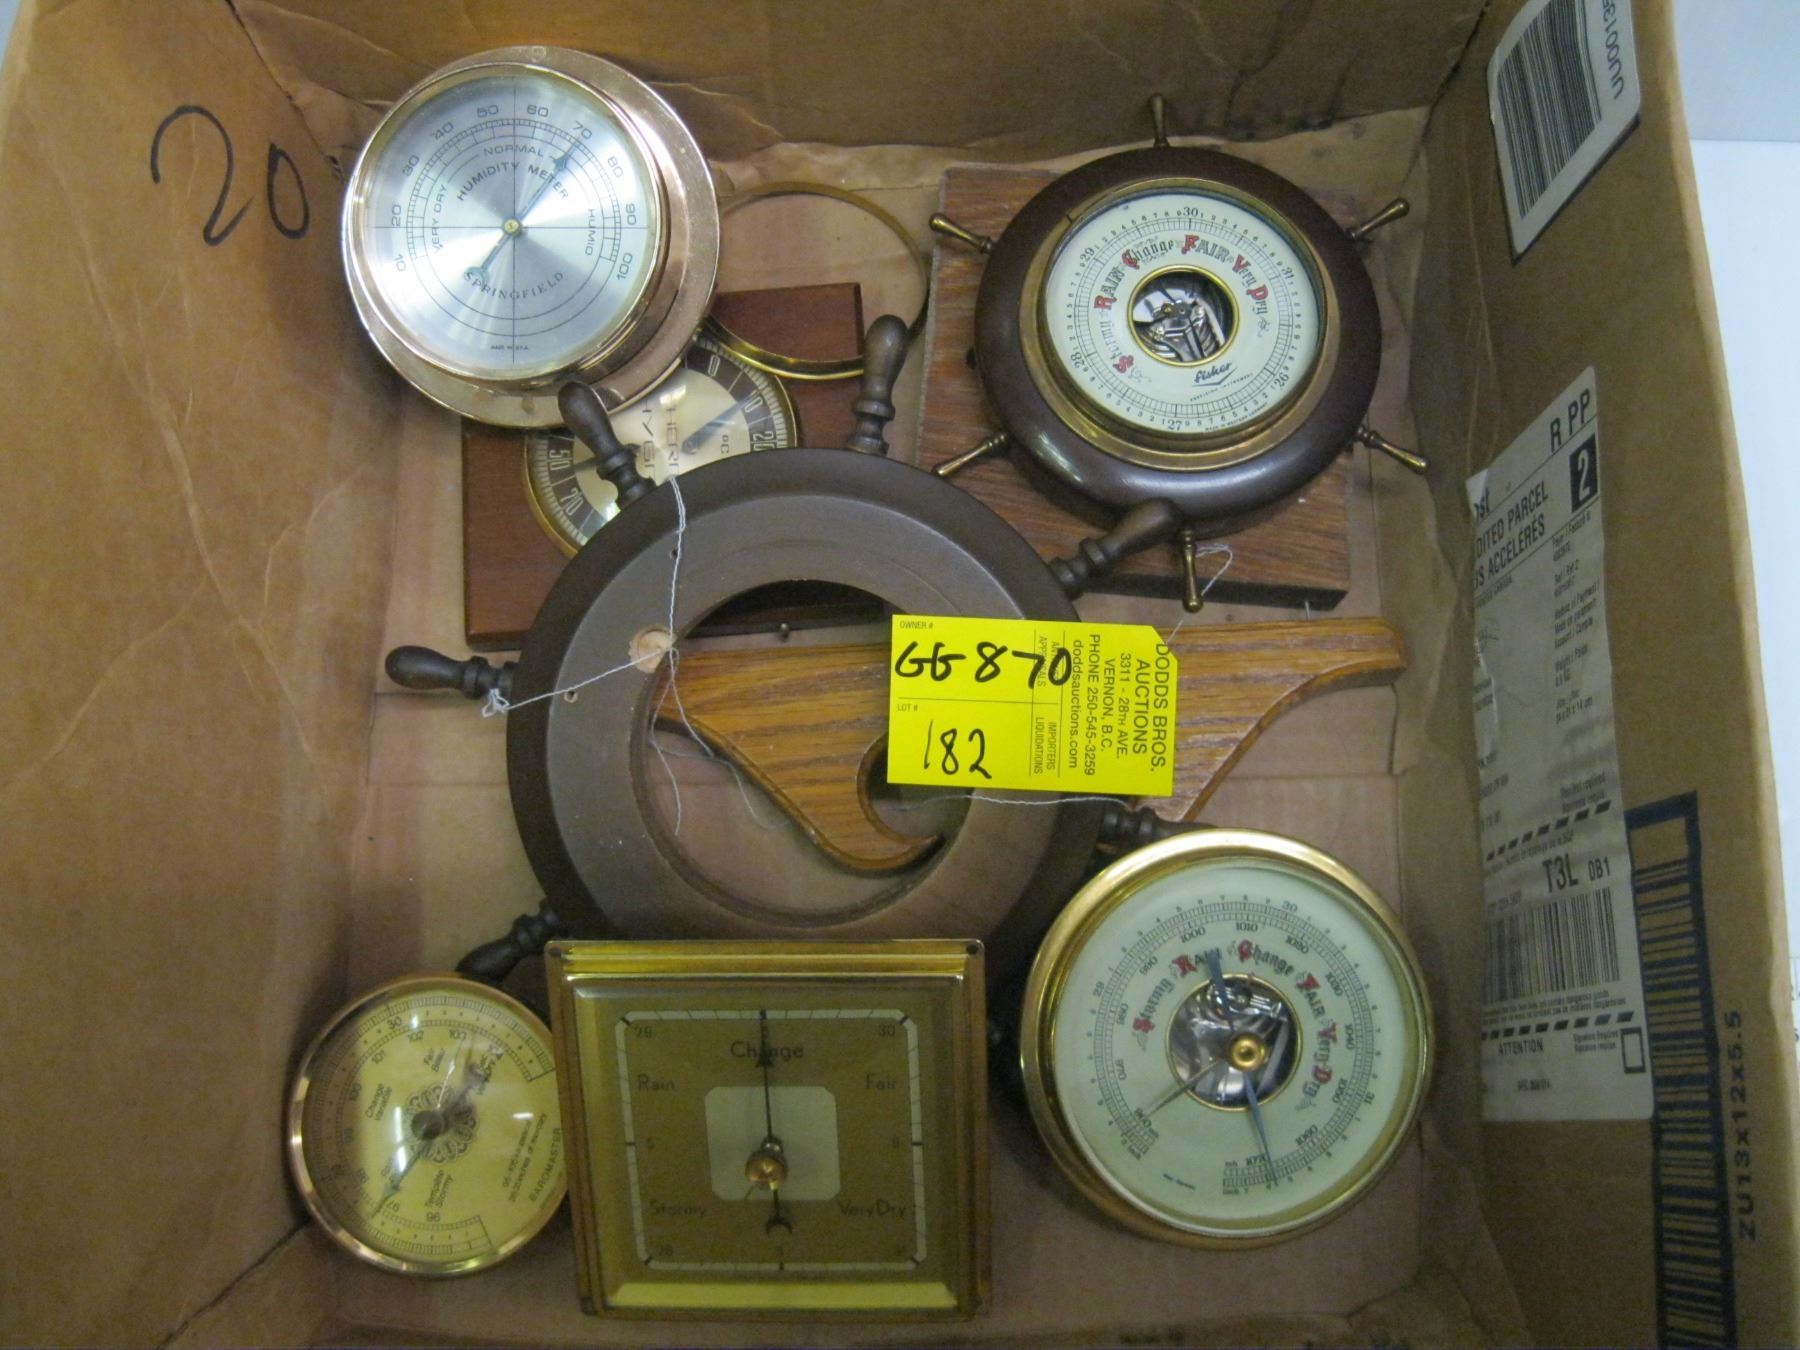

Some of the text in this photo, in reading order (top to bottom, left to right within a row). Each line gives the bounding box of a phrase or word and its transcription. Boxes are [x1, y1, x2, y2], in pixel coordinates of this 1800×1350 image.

[477, 104, 499, 118] 50
[526, 104, 549, 118] 60
[432, 121, 454, 140] 40
[572, 120, 593, 140] 70
[483, 144, 544, 158] NORMAL
[403, 155, 420, 177] 30
[608, 156, 625, 178] 80
[457, 161, 569, 201] HUMIDITY METER
[433, 185, 448, 213] DRY
[391, 204, 402, 226] 20
[625, 203, 637, 225] 90
[1183, 206, 1199, 217] 30
[584, 208, 595, 256] HUMID
[1079, 246, 1096, 262] 29
[1121, 239, 1174, 270] Change
[616, 252, 633, 280] 100
[1281, 266, 1295, 279] 31
[463, 271, 564, 300] SPRINGFIELD
[1070, 351, 1085, 369] 28
[1167, 419, 1182, 431] 27
[1550, 387, 1591, 453] R PP
[1576, 448, 1592, 502] 2
[1475, 518, 1505, 559] DITED
[1507, 480, 1549, 531] PARCEL
[899, 620, 927, 630] OWNER
[1119, 652, 1132, 682] 3311
[897, 703, 912, 712] LOT
[1068, 639, 1084, 769] doddsauctions.com
[1084, 634, 1101, 776] PHONE 250-545-3259
[1100, 657, 1116, 752] VERNON, B.C.
[1132, 659, 1151, 754] AUCTIONS
[1150, 643, 1170, 772] DODDS BROS.
[923, 719, 993, 780] 182
[1033, 716, 1045, 775] LIQUIDATIONS
[1046, 721, 1057, 771] IMPORTERS
[1116, 729, 1128, 759] AVE.
[1541, 853, 1579, 893] T3L
[1180, 926, 1206, 943] 1000
[1235, 922, 1258, 932] 1010
[1237, 939, 1295, 976] Change
[730, 1040, 804, 1063] Chnge
[1499, 1038, 1544, 1056] ATTENTION
[637, 1073, 675, 1091] Rain
[866, 1073, 897, 1090] Fair
